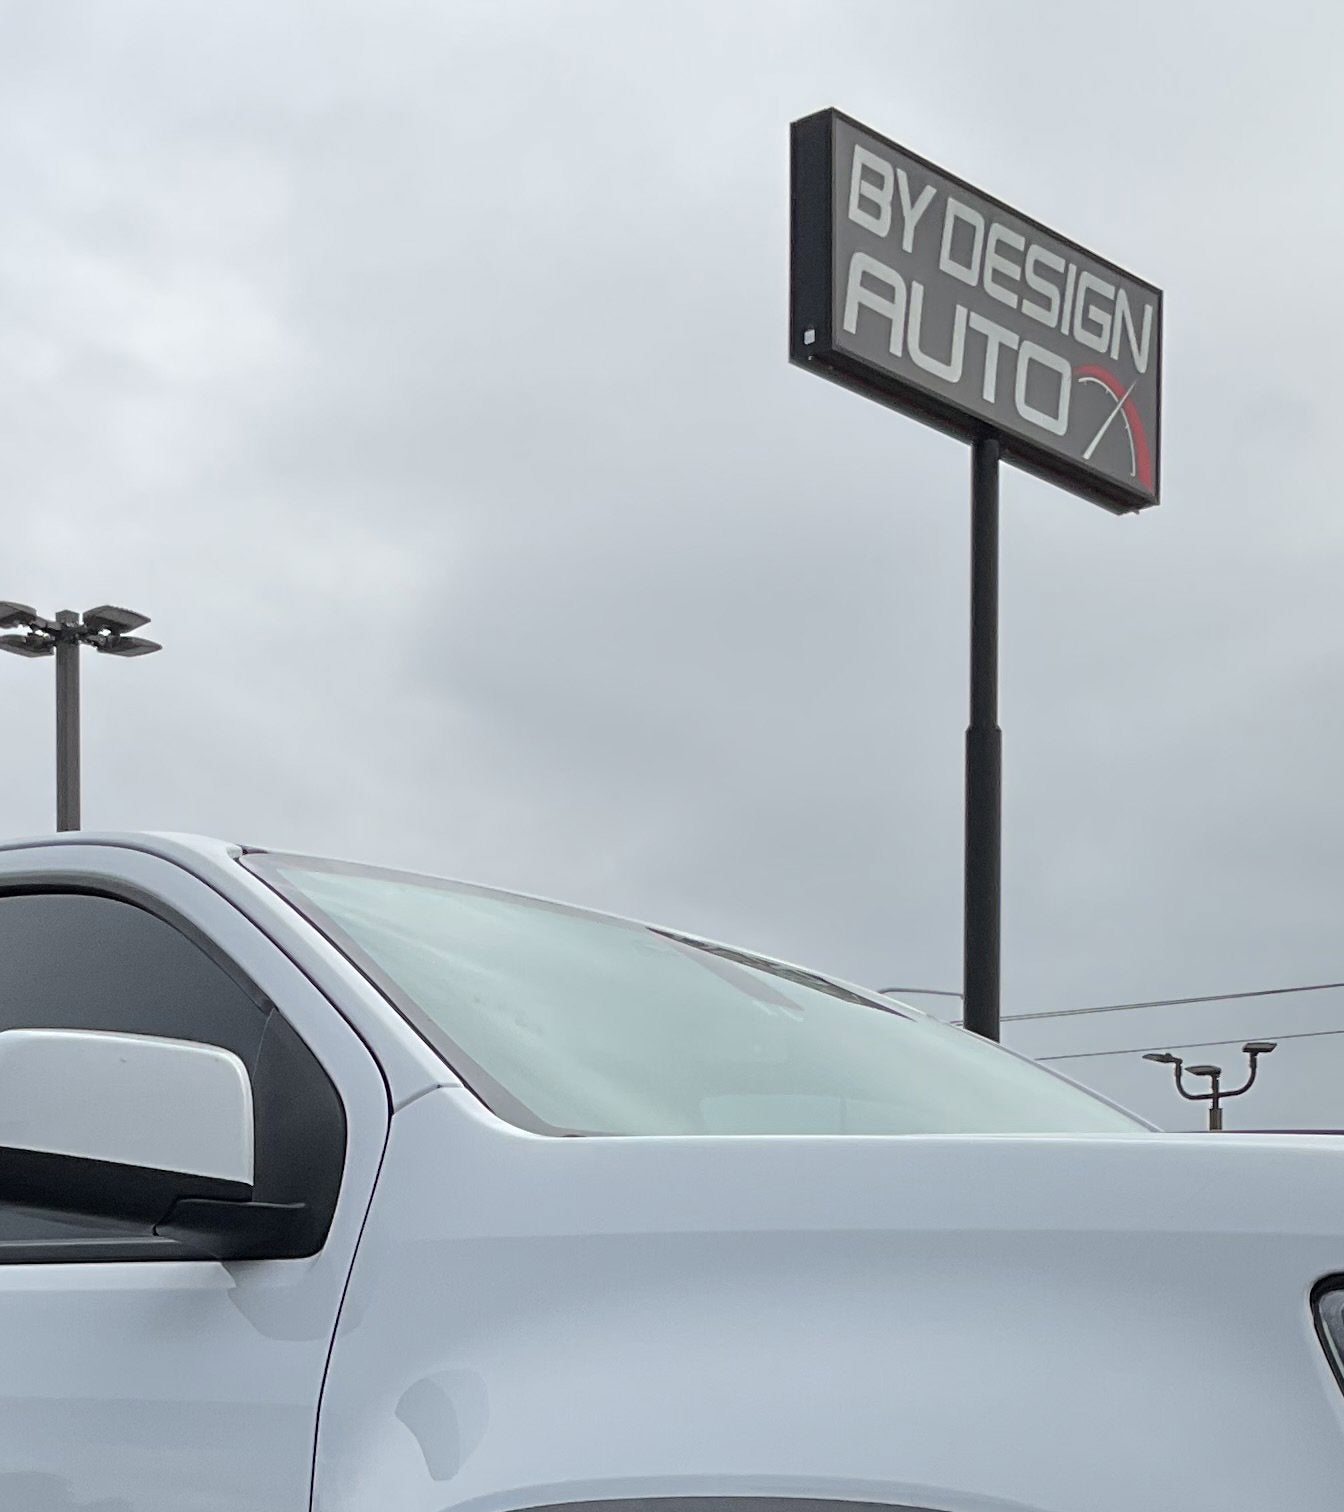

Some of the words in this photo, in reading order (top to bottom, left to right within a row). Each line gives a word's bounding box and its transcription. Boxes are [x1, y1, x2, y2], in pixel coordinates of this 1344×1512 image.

[842, 251, 1074, 437] AUTO
[847, 144, 936, 253] BY
[939, 196, 1153, 374] DESIGN
